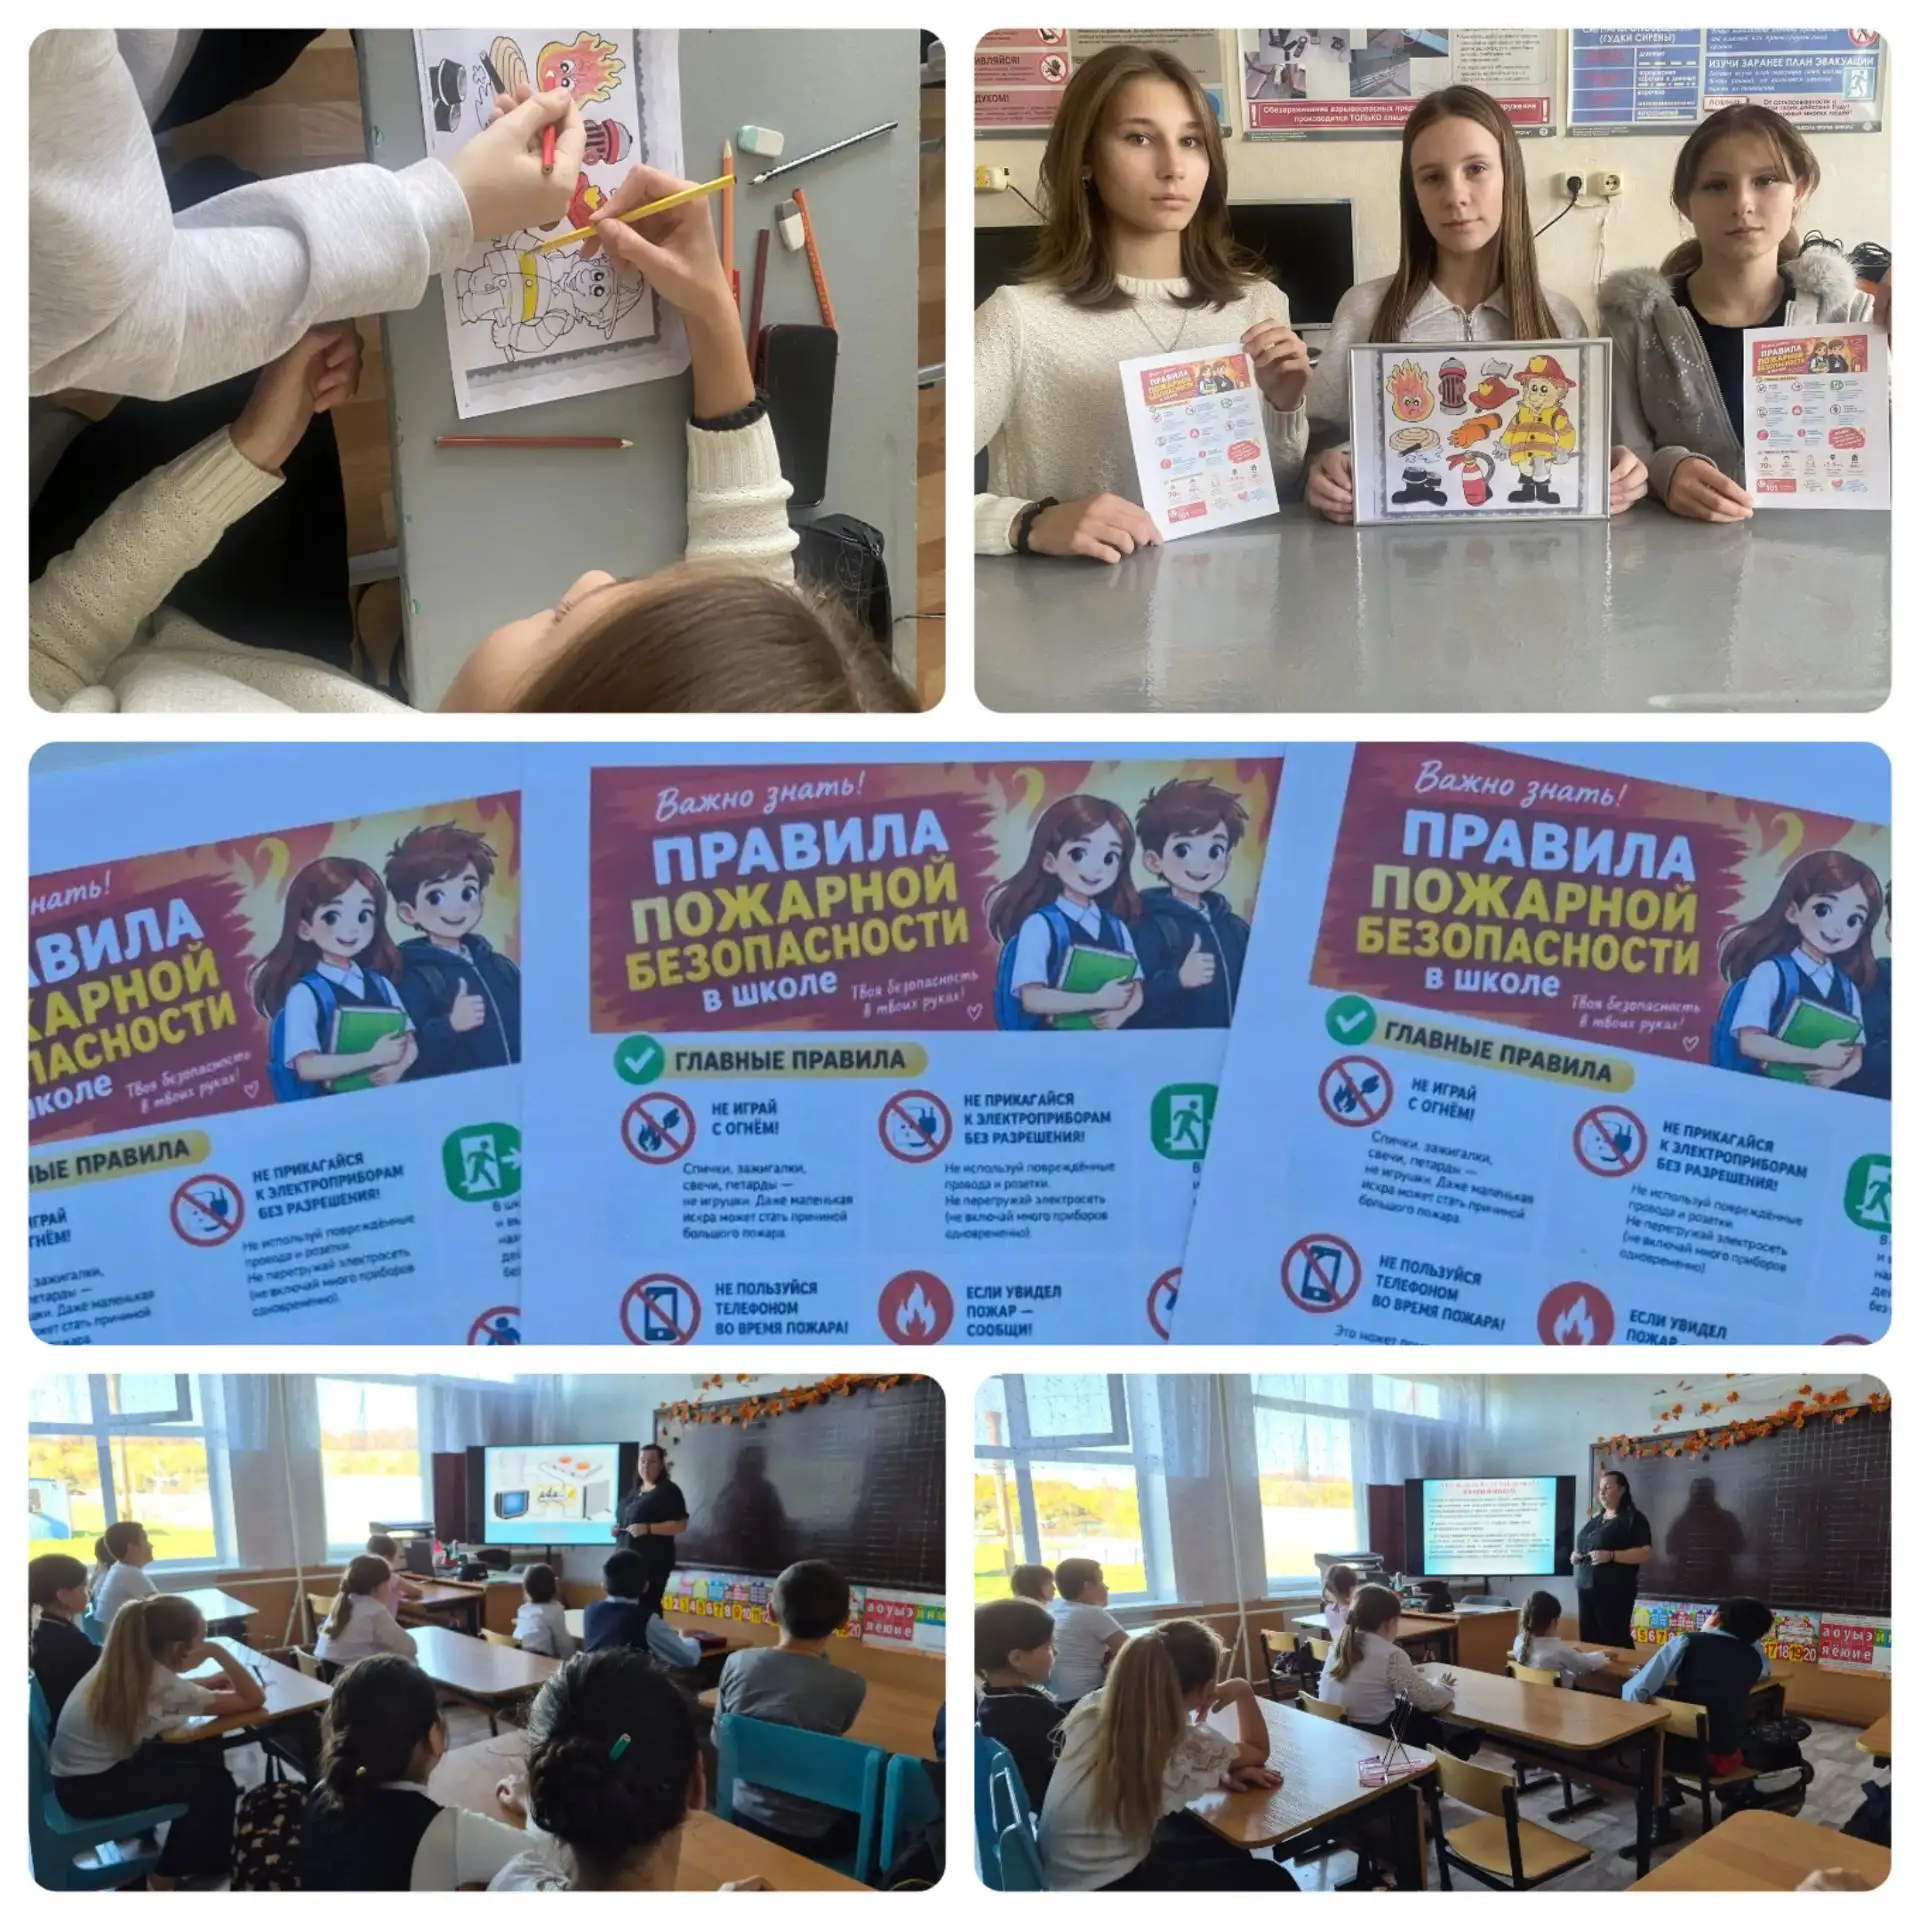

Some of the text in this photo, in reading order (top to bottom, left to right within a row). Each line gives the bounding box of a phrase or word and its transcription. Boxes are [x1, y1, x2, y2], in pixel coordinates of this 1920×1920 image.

[1709, 57, 1874, 68] ИЗУЧИ ЗАРАНЕЕ ПЛАН ЭВАКУАЦИИ
[1350, 114, 1382, 122] ТОЛЬКО
[1413, 760, 1629, 808] Важно знать!
[656, 771, 866, 822] Важно знать!
[652, 809, 950, 886] ПРАВИЛА
[1402, 809, 1696, 882] ПРАВИЛА
[29, 870, 112, 915] нать!
[631, 854, 958, 944] ПОЖАРНОЙ
[1371, 864, 1698, 934] ПОЖАРНОЙ
[626, 907, 969, 991] БЕЗОПАСНОСТИ
[1356, 916, 1700, 975] БЕЗОПАСНОСТИ
[703, 969, 838, 1013] в школе
[851, 970, 979, 1001] Твоя безопасность
[1424, 966, 1560, 997] в школе
[864, 985, 965, 1018] в твоих руках!
[1572, 994, 1701, 1014] Твоя безопасность
[1579, 1014, 1684, 1032] в твоих руках!
[675, 1048, 906, 1071] ГЛАВНЫЕ ПРАВИЛА
[1384, 1021, 1612, 1083] ГЛАВНЫЕ ПРАВИЛА
[125, 1051, 252, 1098] Твоя безопасность
[965, 1091, 1074, 1107] НЕ ПРИКАГАЙСЯ
[1411, 1077, 1477, 1101] НЕ ИГРАЙ
[712, 1099, 777, 1116] НЕ ИГРАЙ
[965, 1111, 1111, 1126] К ЭЛЕКТРОПРИБОРАМ
[1408, 1097, 1475, 1121] С ОГНЁМ!
[712, 1120, 779, 1136] С ОГНЁМ!
[965, 1131, 1085, 1145] БЕЗ РАЗРЕШЕНИЯ!
[1663, 1120, 1774, 1152] НЕ ПРИКАГАЙСЯ
[76, 1139, 190, 1176] ПРАВИЛА
[253, 1151, 363, 1183] НЕ ПРИКАГАЙСЯ
[945, 1162, 1115, 1176] Не используй повреждённые
[1368, 1149, 1462, 1175] свечи, петарды
[1660, 1140, 1807, 1178] К ЭЛЕКТРОПРИБОРАМ
[737, 1164, 806, 1175] зажигалки,
[1656, 1158, 1778, 1192] БЕЗ РАЗРЕШЕНИЯ!
[256, 1164, 404, 1201] К ЭЛЕКТРОПРИБОРАМ
[683, 1180, 777, 1192] свечи, петарды
[945, 1179, 991, 1192] провода
[994, 1180, 1000, 1189] и
[258, 1188, 380, 1220] БЕЗ РАЗРЕШЕНИЯ!
[683, 1196, 697, 1206] не
[755, 1195, 787, 1208] Даже
[790, 1195, 853, 1206] маленькая
[945, 1195, 1106, 1209] Не перегружай электросеть
[683, 1210, 847, 1224] искра может стать причиной
[945, 1209, 1107, 1224] (не включай много приборов
[683, 1227, 739, 1240] большого
[1379, 1255, 1482, 1286] НЕ ПОЛЬЗУЙСЯ
[716, 1280, 817, 1296] НЕ ПОЛЬЗУЙСЯ
[966, 1286, 1061, 1299] ЕСЛИ УВИДЕЛ
[1376, 1274, 1459, 1301] ТЕЛЕФОНОМ
[716, 1301, 798, 1316] ТЕЛЕФОНОМ
[966, 1306, 1016, 1318] ПОЖАР
[1371, 1294, 1505, 1331] ВО ВРЕМЯ ПОЖАРА!
[716, 1321, 848, 1335] ВО ВРЕМЯ ПОЖАРА!
[967, 1323, 1032, 1338] СООБЩИ!
[1629, 1309, 1727, 1340] ЕСЛИ УВИДЕЛ
[1626, 1329, 1677, 1345] ПОЖАР
[1648, 1630, 1655, 1641] 6
[1779, 1644, 1789, 1659] 18
[1803, 1647, 1816, 1661] 20
